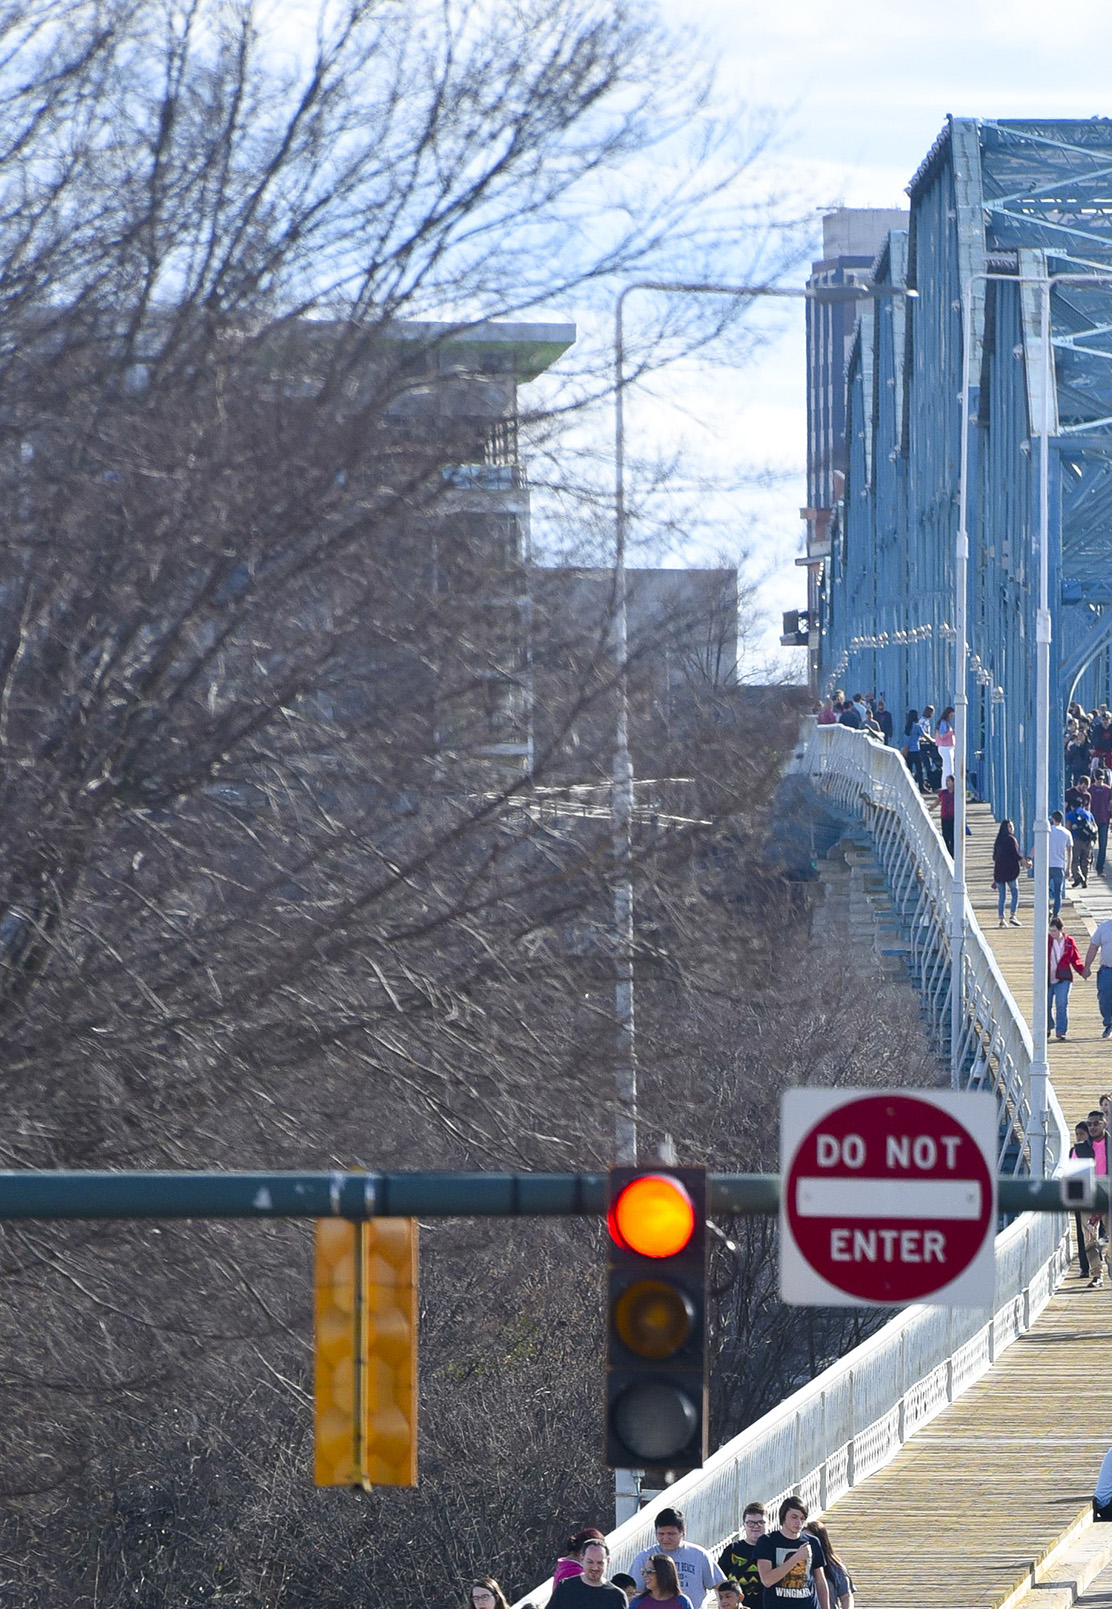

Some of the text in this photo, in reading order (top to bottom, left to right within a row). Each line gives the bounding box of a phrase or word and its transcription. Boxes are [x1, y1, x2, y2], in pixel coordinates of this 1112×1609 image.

[816, 1134, 961, 1170] DO NOT
[830, 1228, 946, 1264] ENTER
